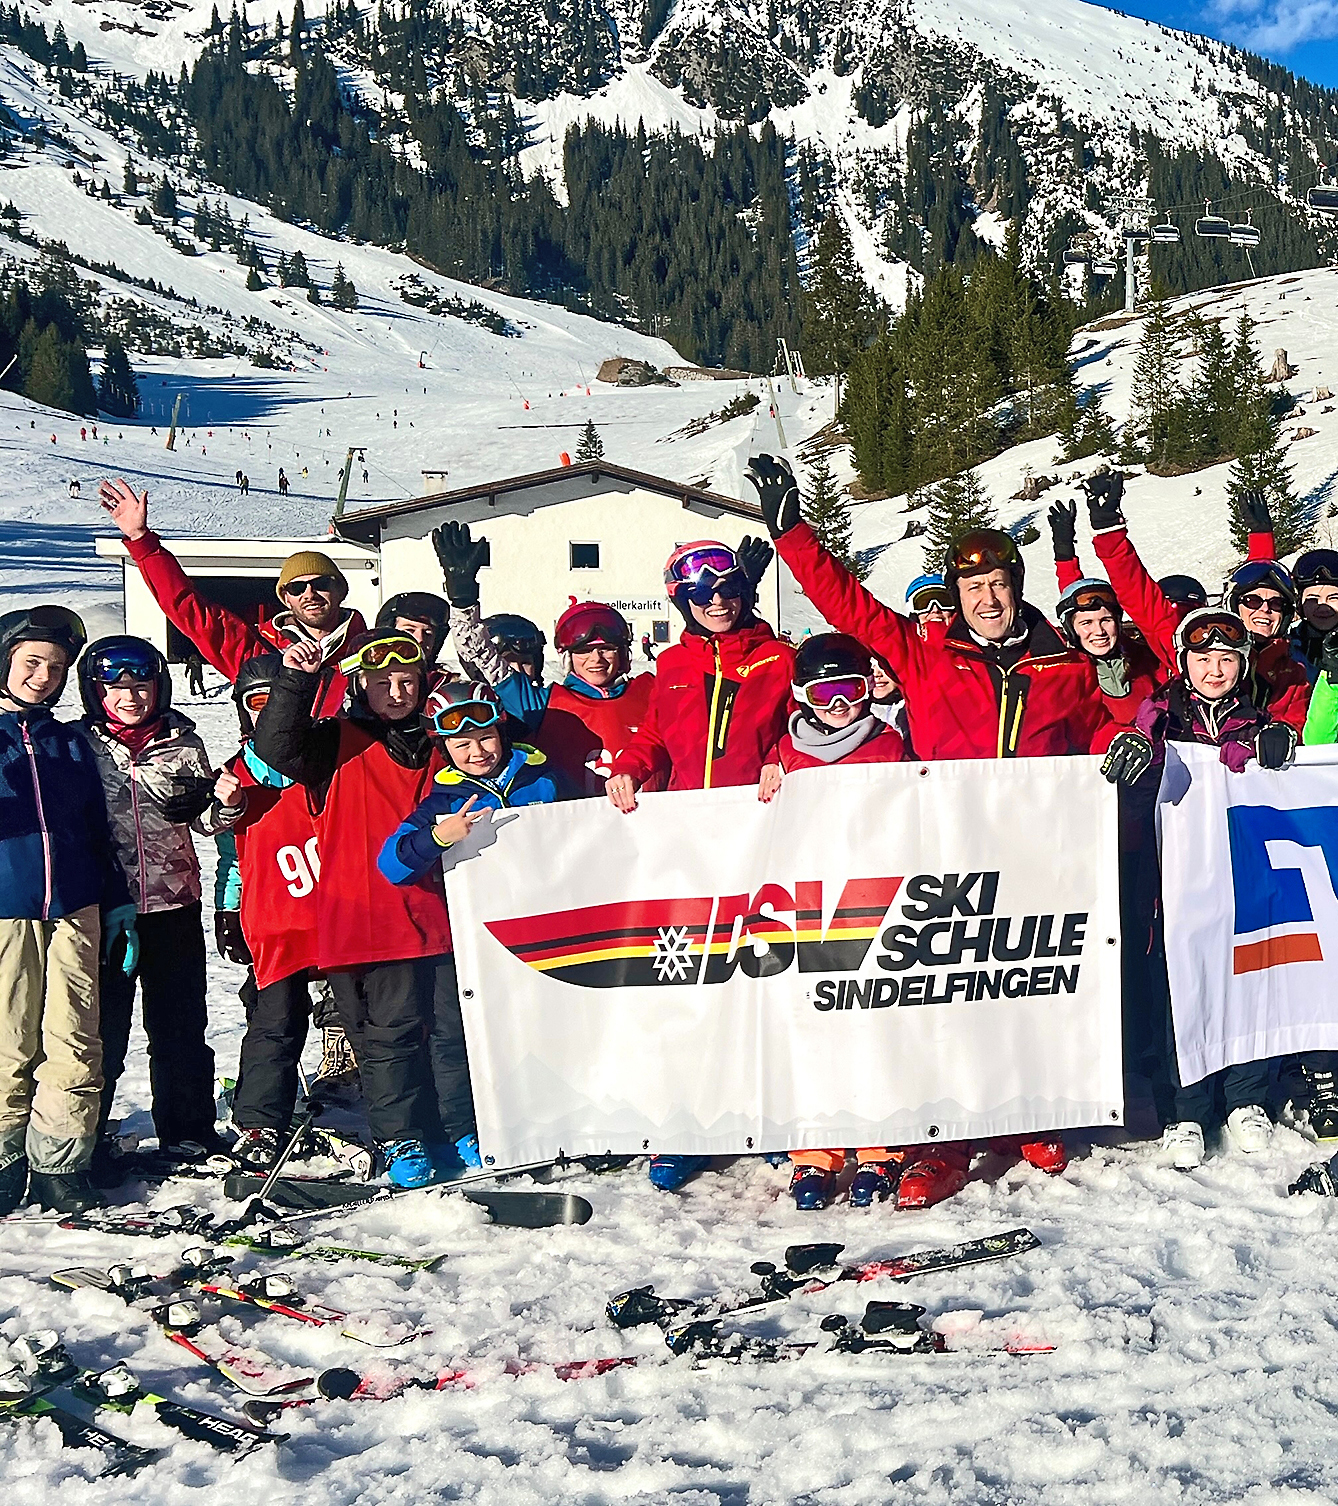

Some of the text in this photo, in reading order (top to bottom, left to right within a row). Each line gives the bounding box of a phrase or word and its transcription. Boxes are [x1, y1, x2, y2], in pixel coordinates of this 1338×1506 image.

[901, 871, 1000, 921] SKI
[876, 912, 1089, 972] SCHULE
[813, 963, 1082, 1012] SINDELFINGEN
